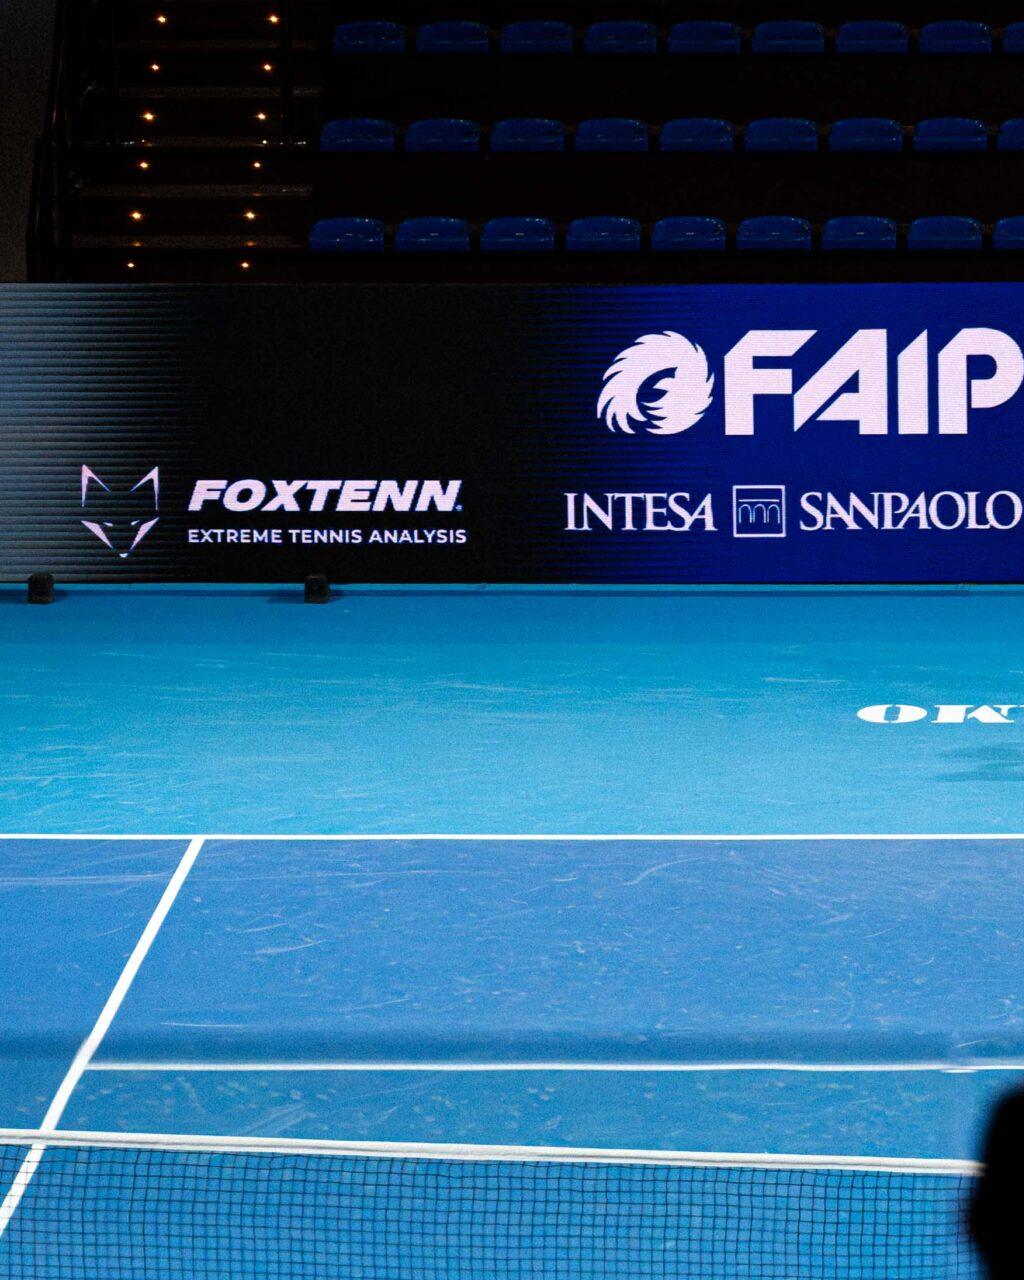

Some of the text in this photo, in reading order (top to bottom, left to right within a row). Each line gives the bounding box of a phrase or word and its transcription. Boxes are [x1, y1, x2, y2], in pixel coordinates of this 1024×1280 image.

[724, 327, 1024, 435] FAIP
[188, 479, 463, 512] FOXTENN
[564, 490, 1024, 532] INTESA SANPAOLO
[188, 529, 467, 544] EXTREME TENNIS ANALYSIS
